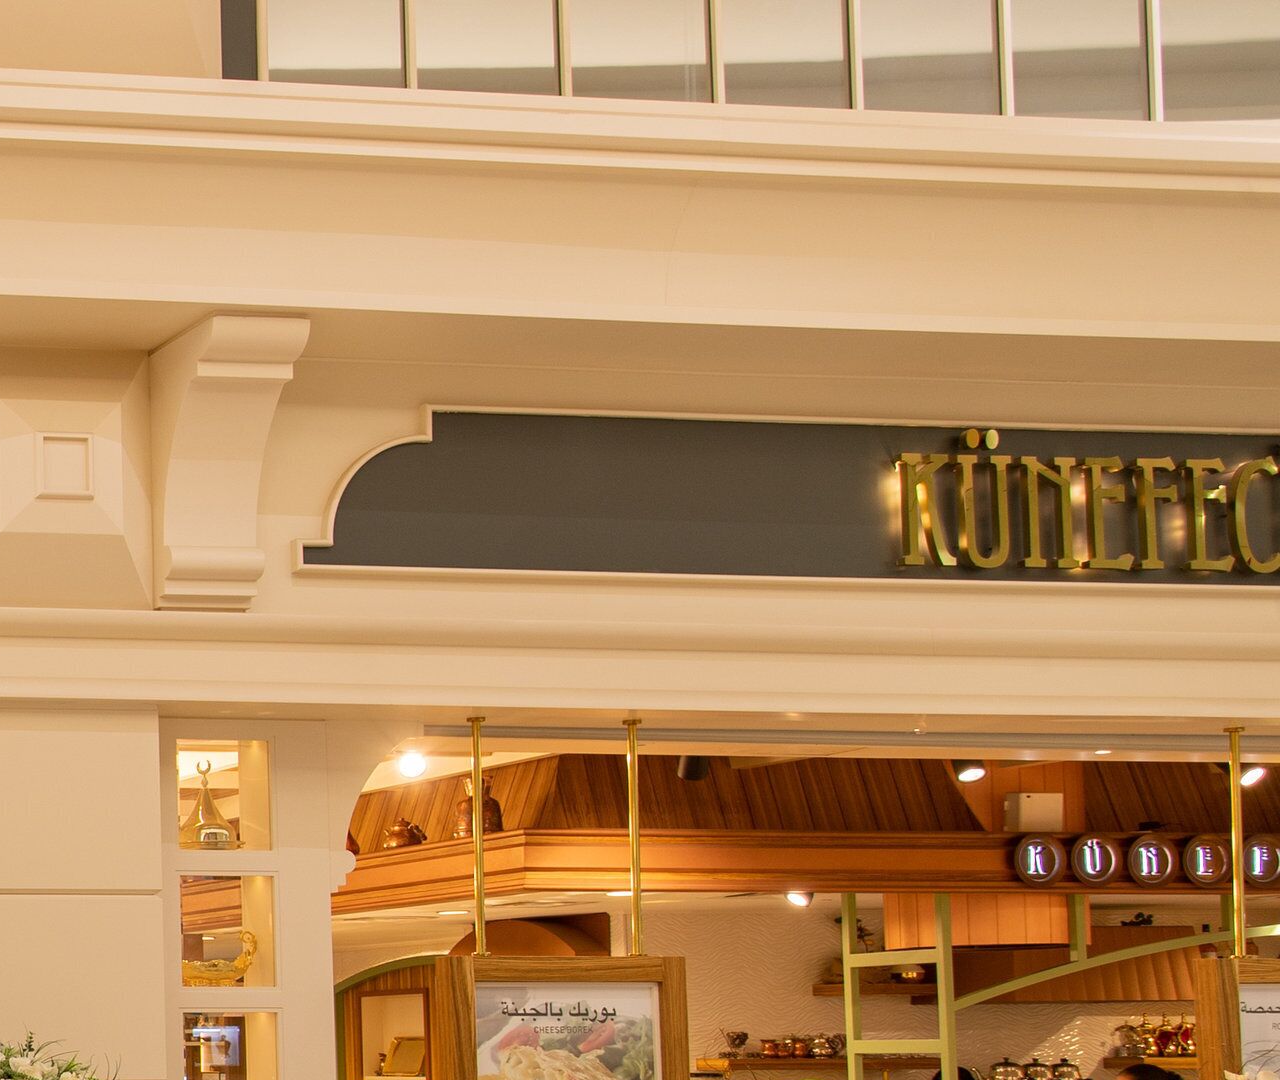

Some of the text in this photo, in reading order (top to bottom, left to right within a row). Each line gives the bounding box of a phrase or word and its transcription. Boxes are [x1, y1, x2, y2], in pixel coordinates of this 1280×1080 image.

[501, 1001, 617, 1023] بوريك بالجبنة
[534, 1025, 565, 1034] CHEESE
